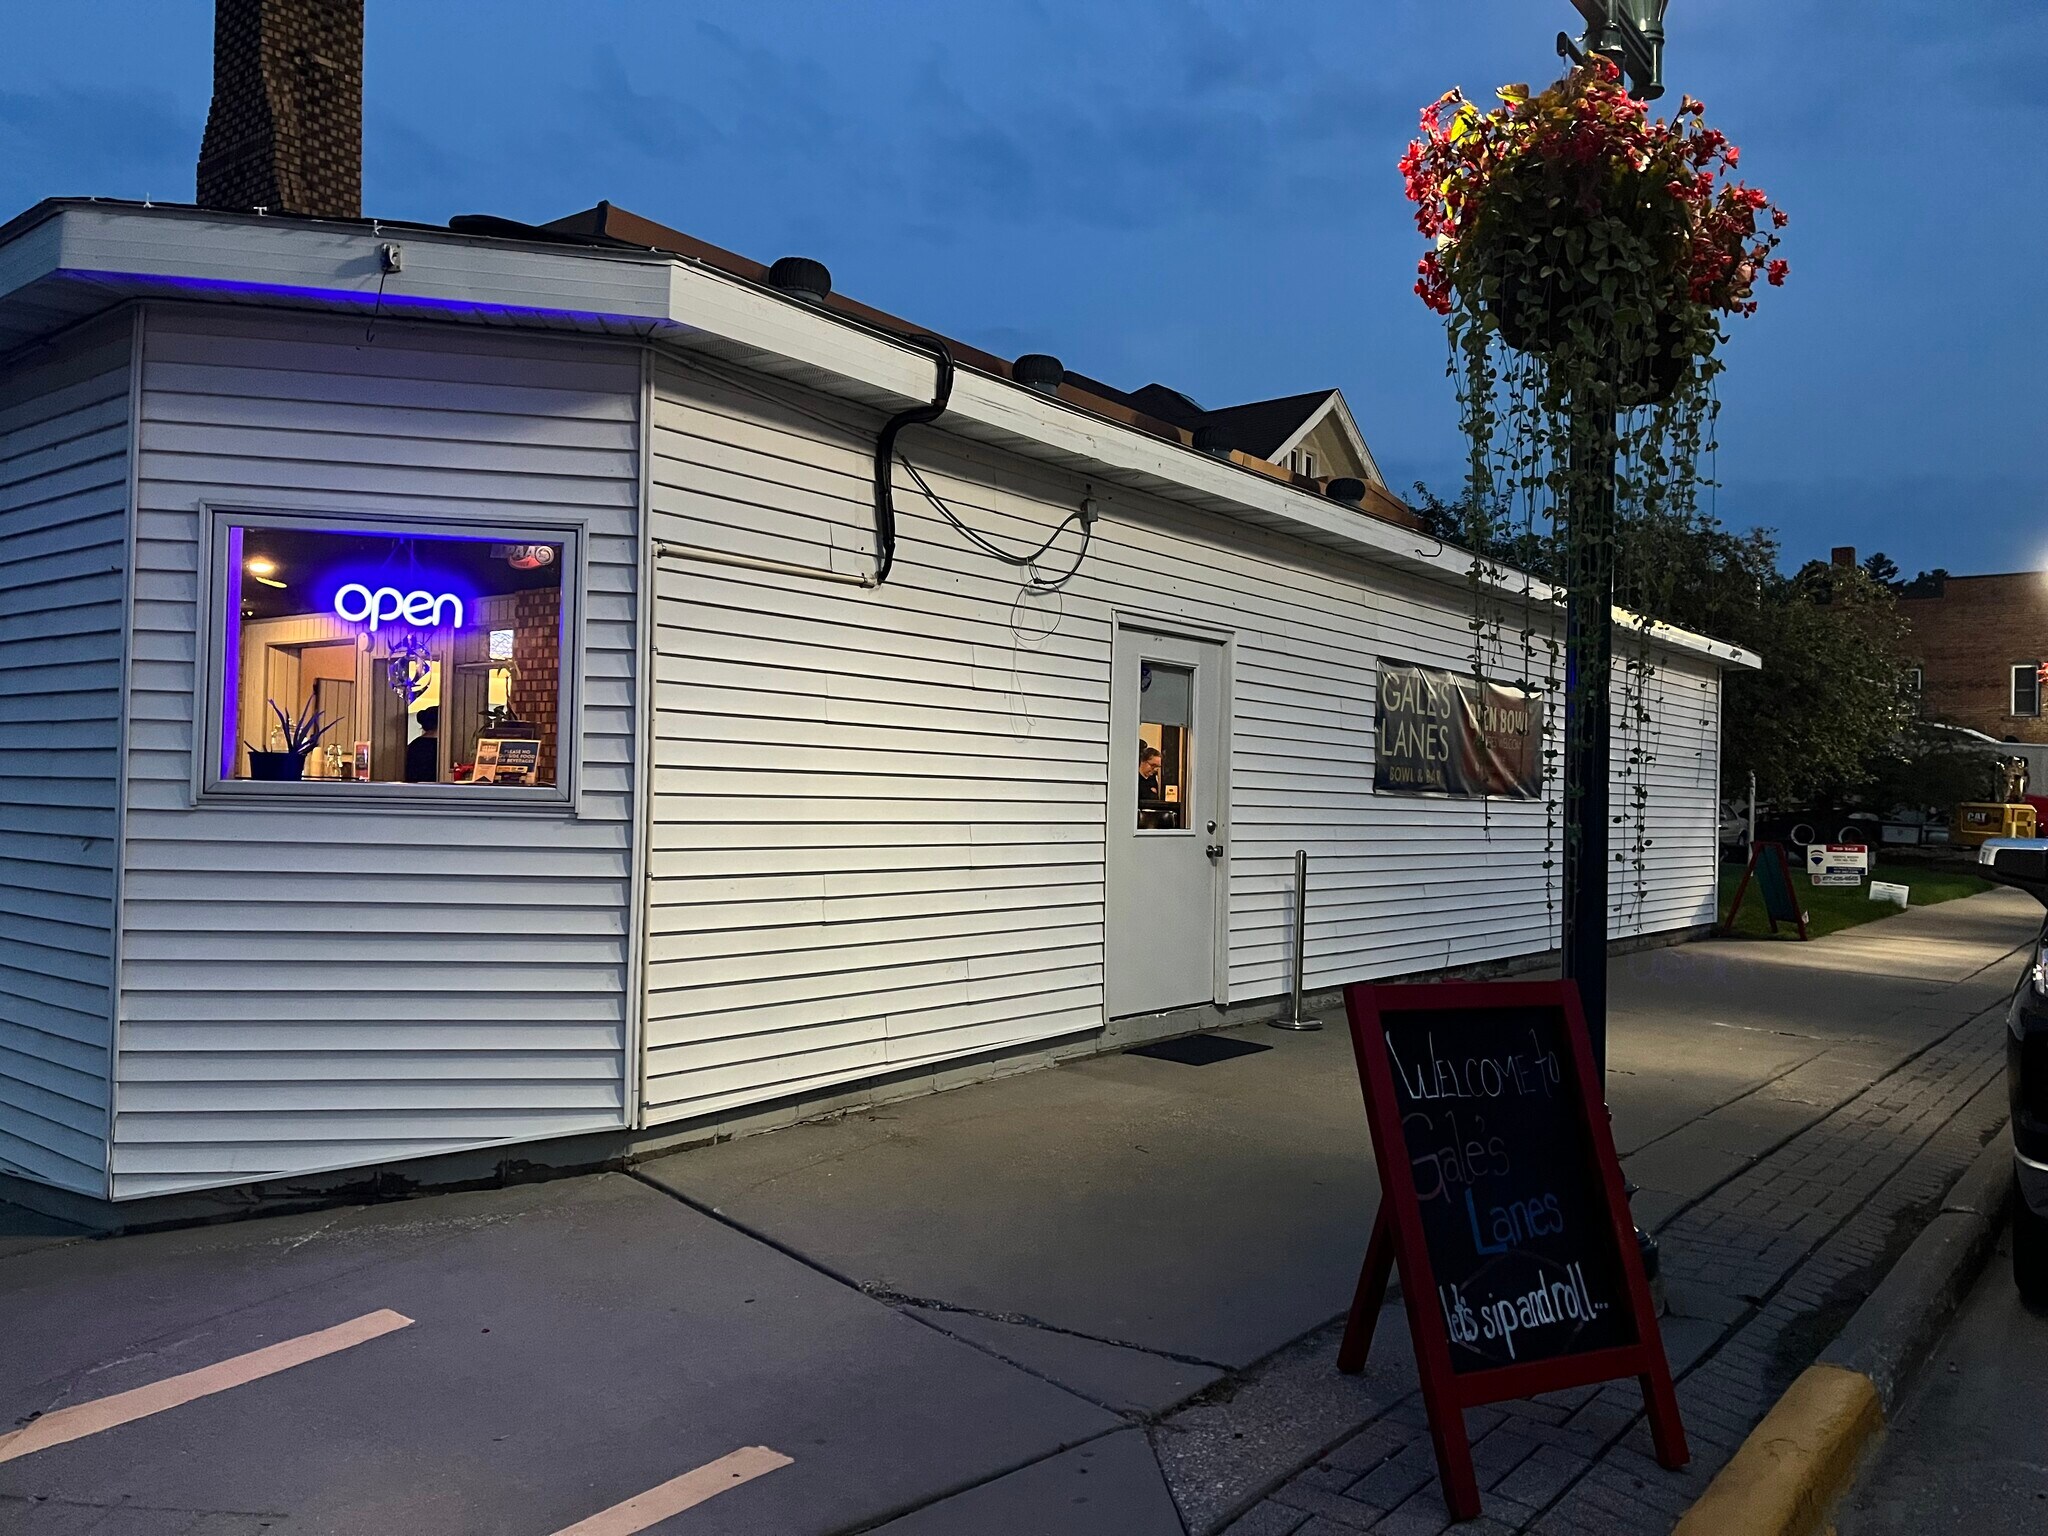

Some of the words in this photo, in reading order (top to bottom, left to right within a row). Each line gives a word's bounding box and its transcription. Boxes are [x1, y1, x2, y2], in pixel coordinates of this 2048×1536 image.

[334, 583, 463, 632] open
[1382, 673, 1451, 719] GALE'S
[1381, 718, 1449, 762] LANES
[1389, 766, 1414, 783] BOWL
[1417, 768, 1424, 783] &
[1426, 768, 1441, 784] BAR
[1967, 812, 1987, 823] CAT
[1529, 1028, 1561, 1098] to
[1402, 1109, 1510, 1204] Gale's
[1465, 1187, 1564, 1256] Lanes
[1482, 1292, 1517, 1360] sip
[1519, 1268, 1557, 1329] and
